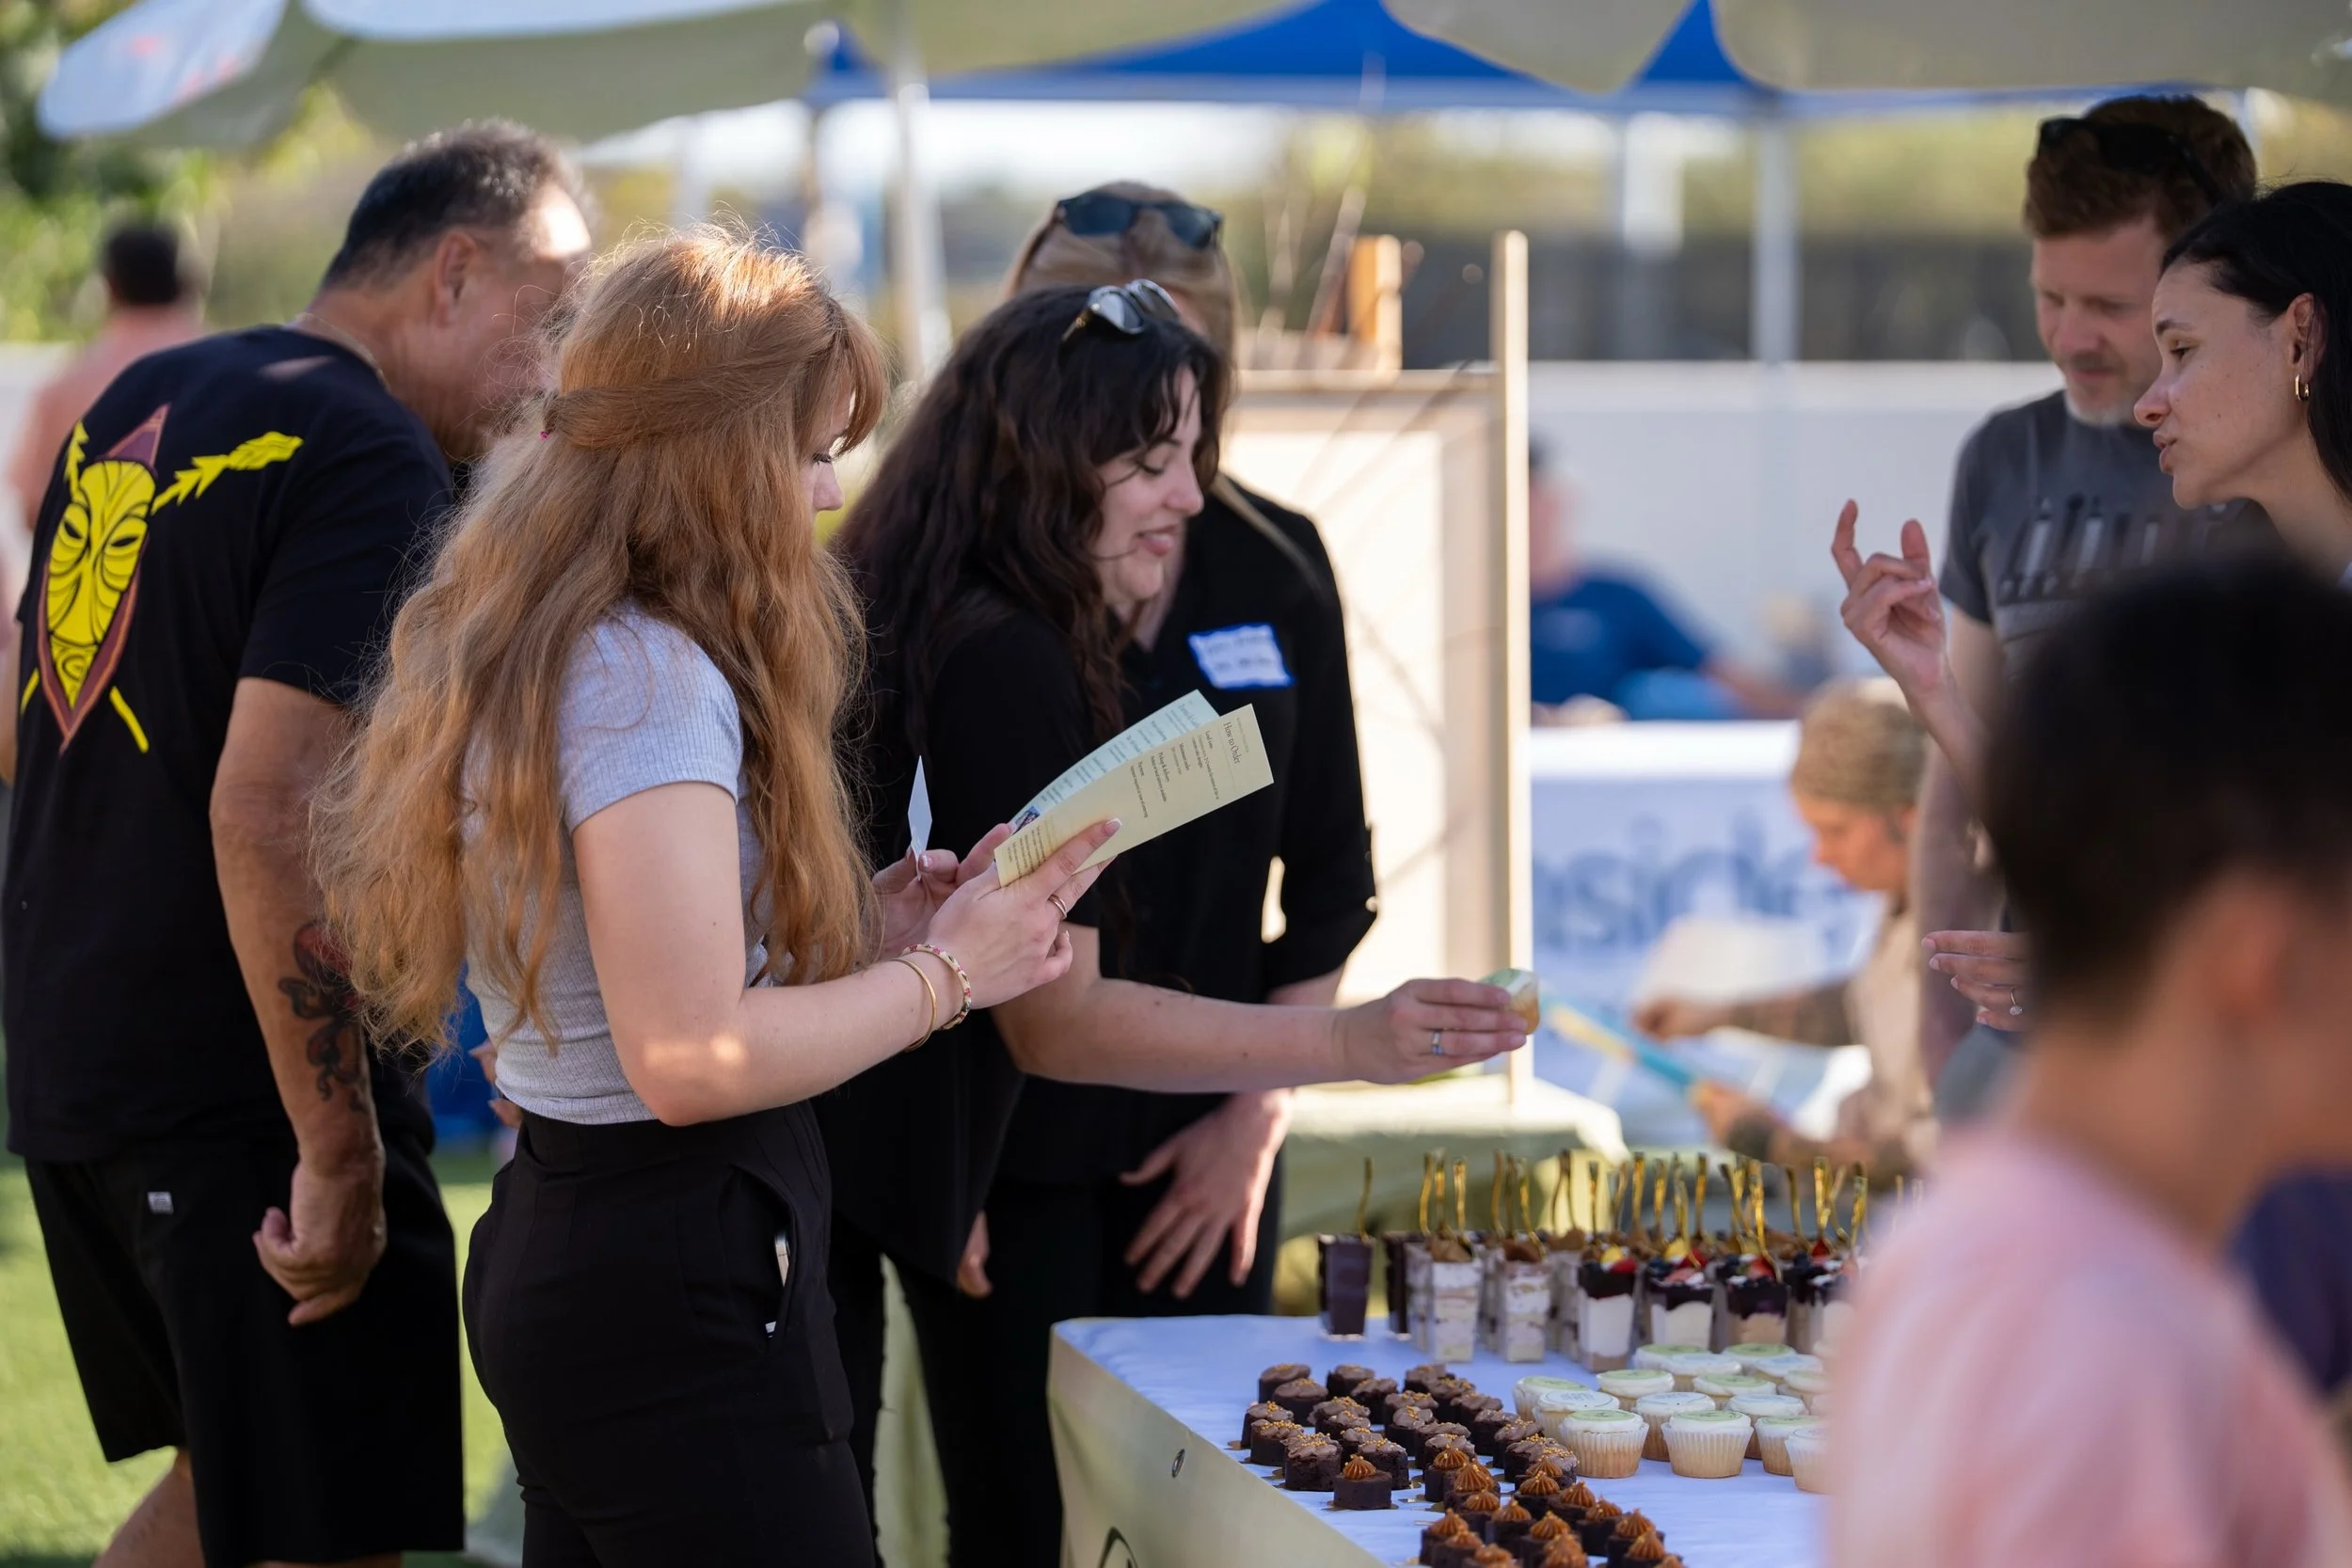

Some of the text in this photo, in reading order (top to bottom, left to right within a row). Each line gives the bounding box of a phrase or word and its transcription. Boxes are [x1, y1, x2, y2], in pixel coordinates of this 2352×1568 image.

[1223, 721, 1242, 764] How to Order
